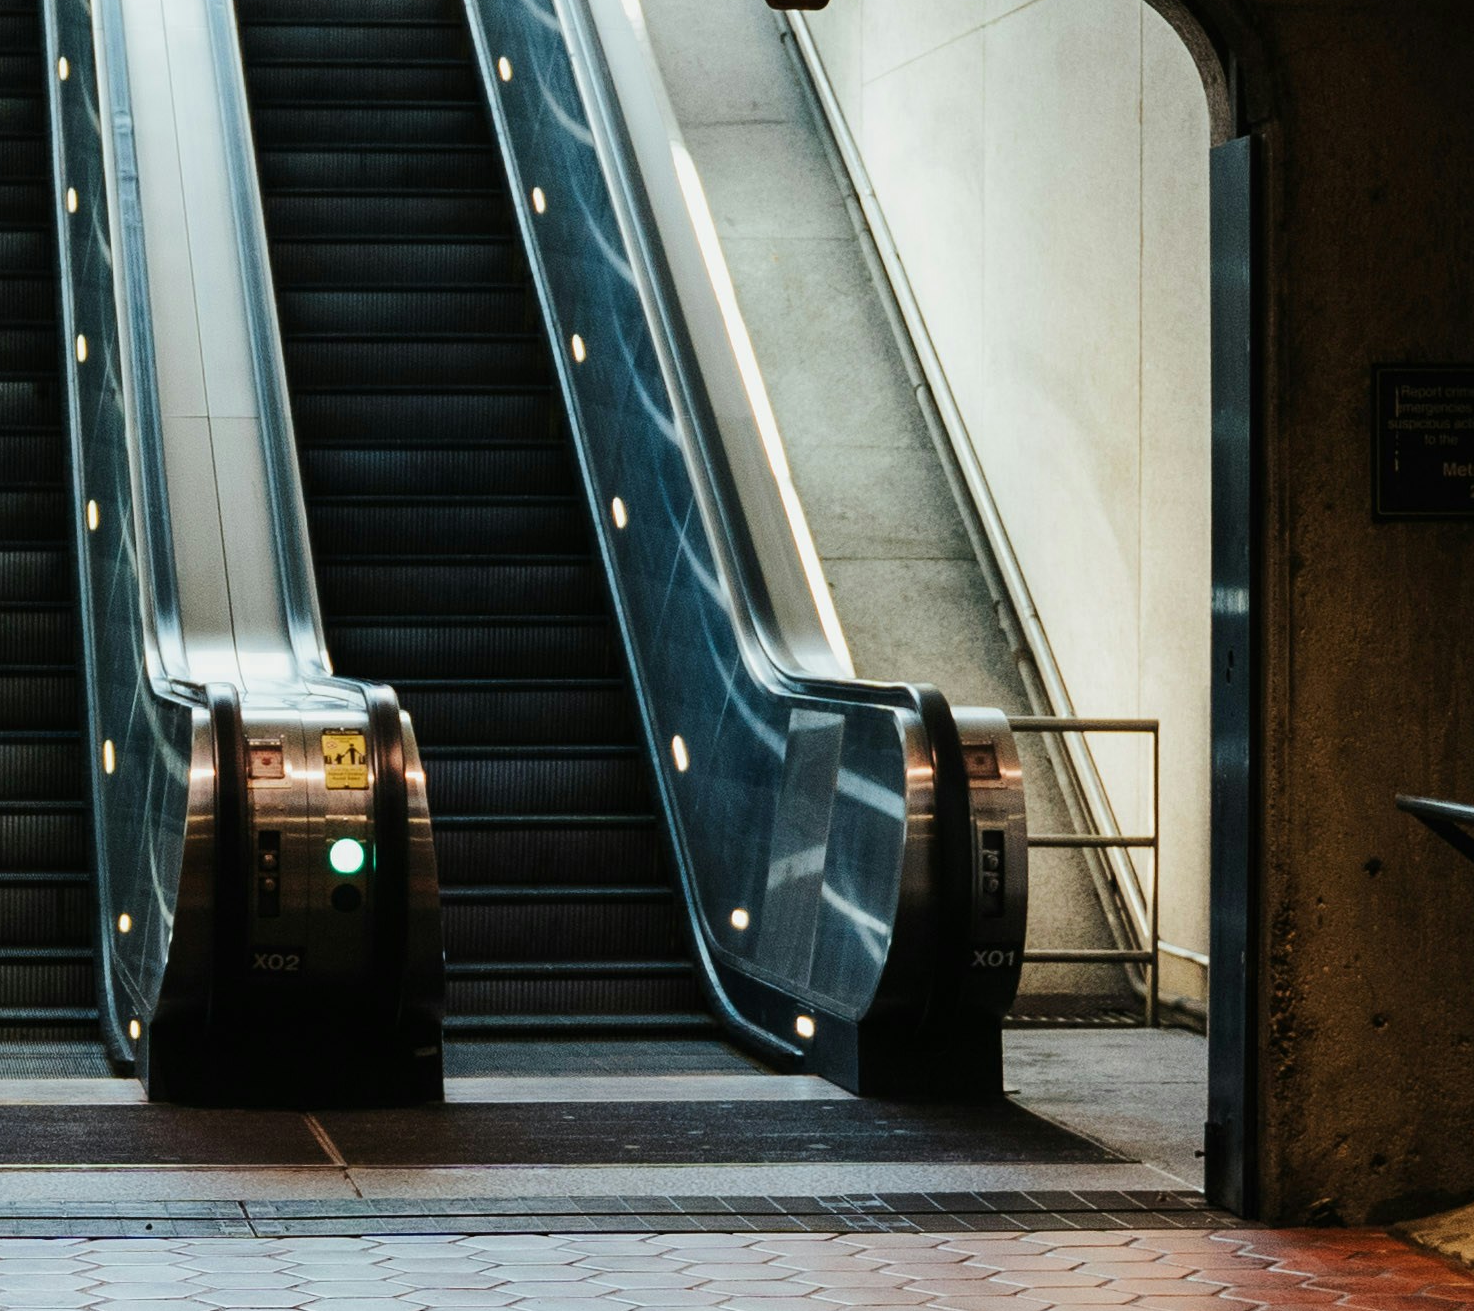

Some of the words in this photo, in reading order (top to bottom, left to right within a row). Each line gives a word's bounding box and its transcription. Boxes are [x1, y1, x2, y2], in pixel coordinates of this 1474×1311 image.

[1401, 385, 1442, 399] Report
[1387, 419, 1451, 431] suspicious
[1424, 434, 1436, 446] to
[1439, 434, 1459, 446] the
